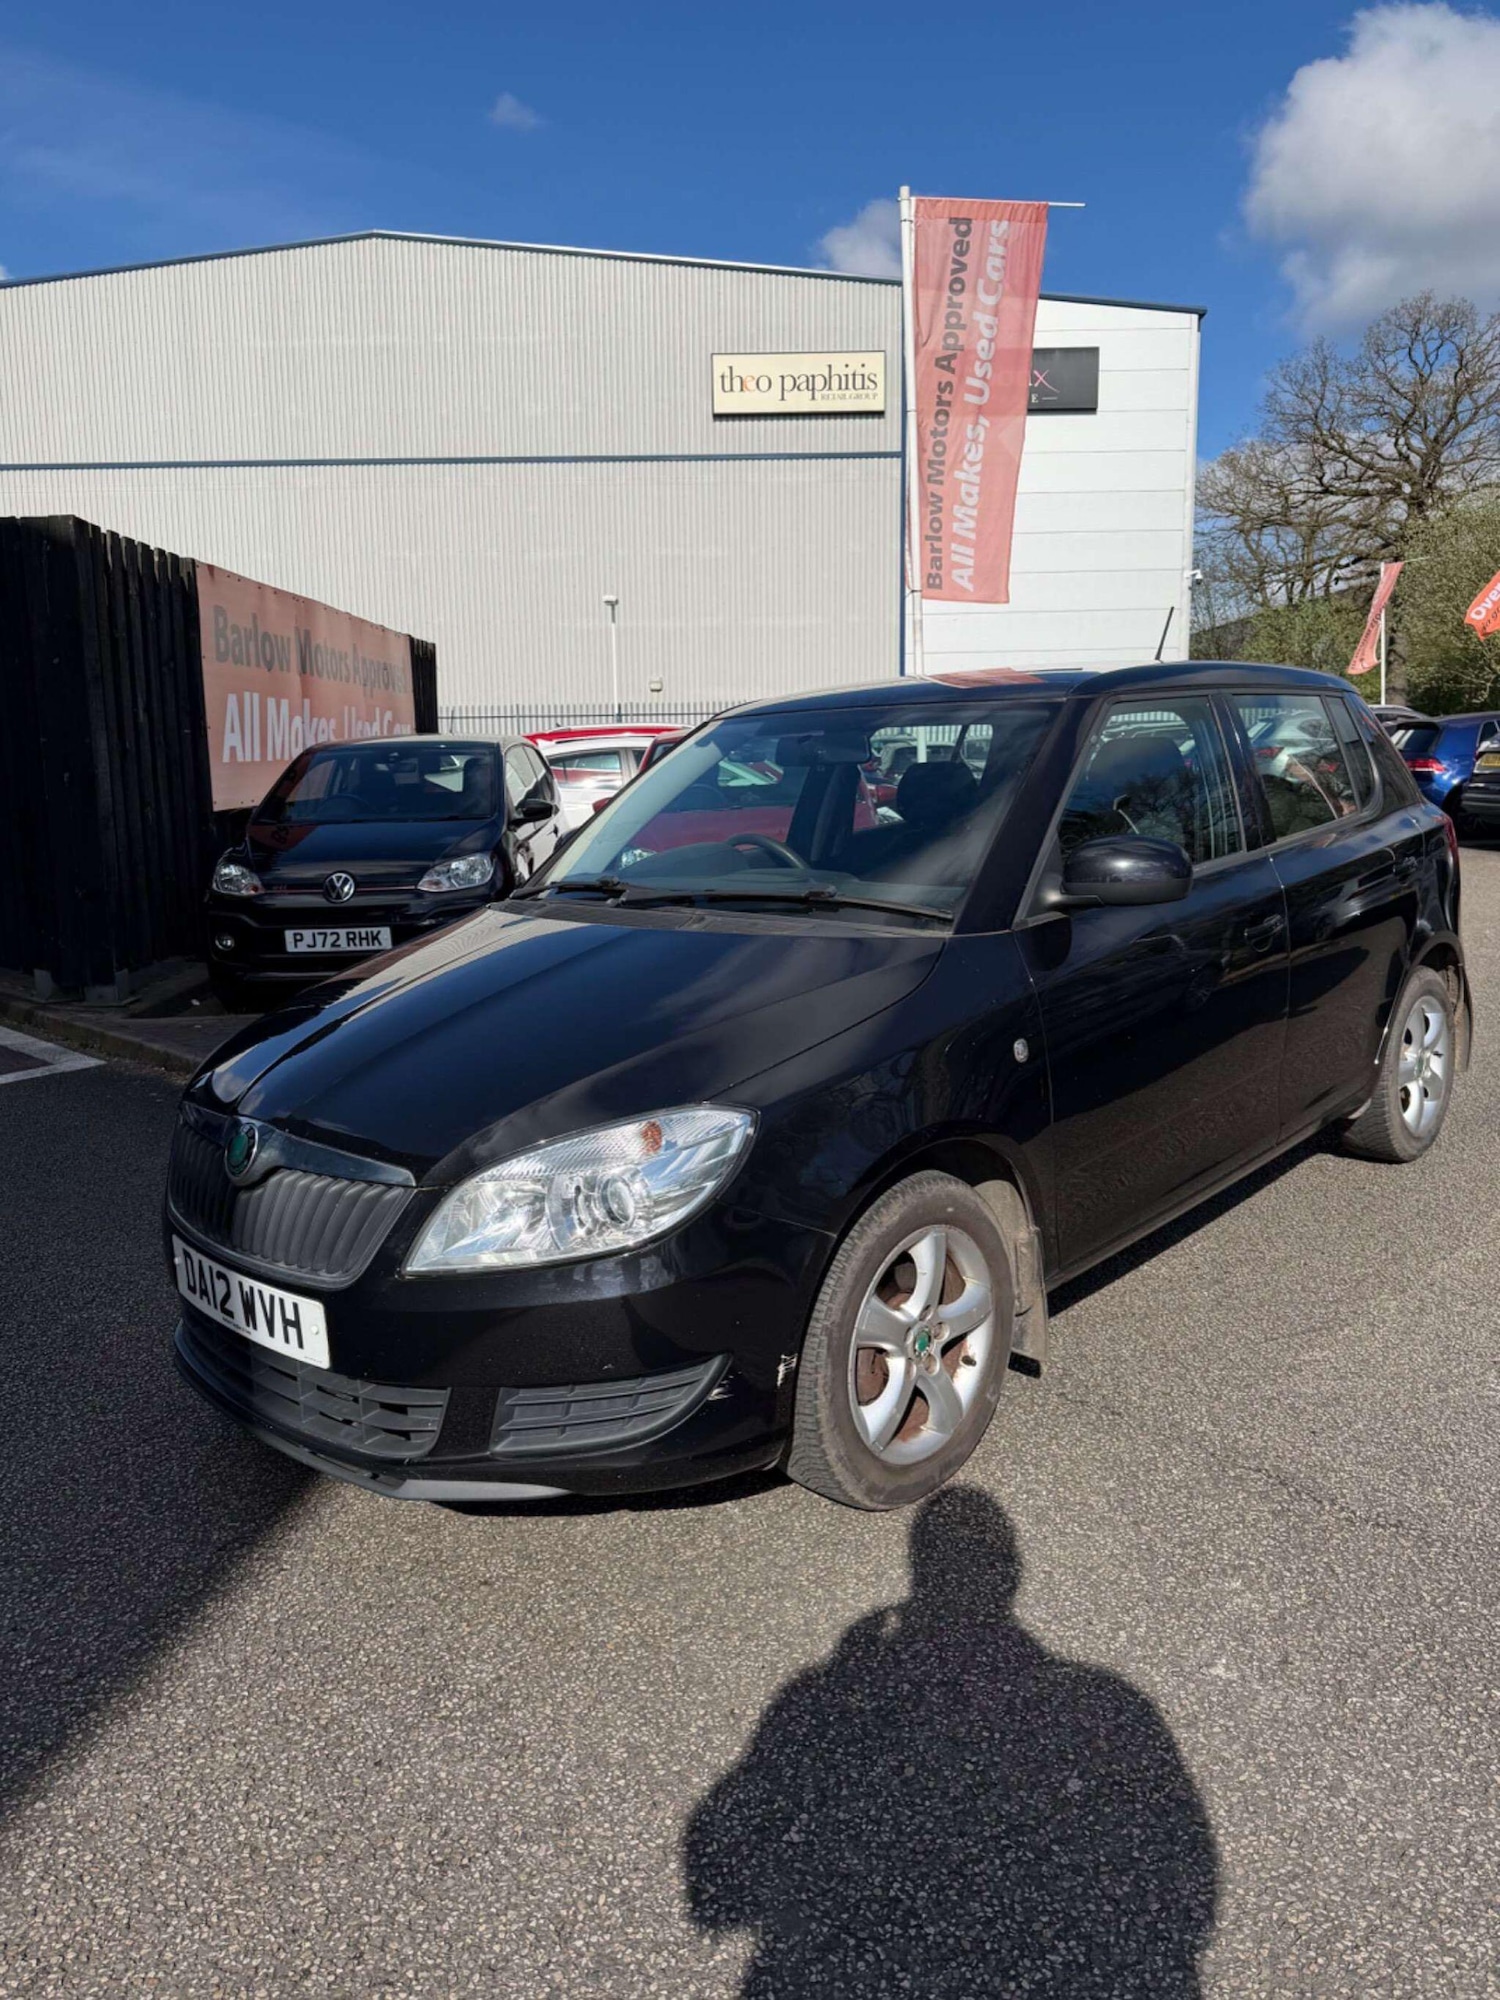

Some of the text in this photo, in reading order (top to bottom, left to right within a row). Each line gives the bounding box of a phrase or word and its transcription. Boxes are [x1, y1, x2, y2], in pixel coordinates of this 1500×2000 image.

[719, 363, 878, 401] theo paphitis
[925, 217, 973, 590] Barlow Motors Approved
[950, 219, 1010, 592] All Makes, Used Cars
[213, 604, 410, 699] Barlow Motors Approved
[222, 691, 261, 763] All
[293, 930, 383, 949] PJ72 RHK
[182, 1247, 304, 1350] DA12 WVH
